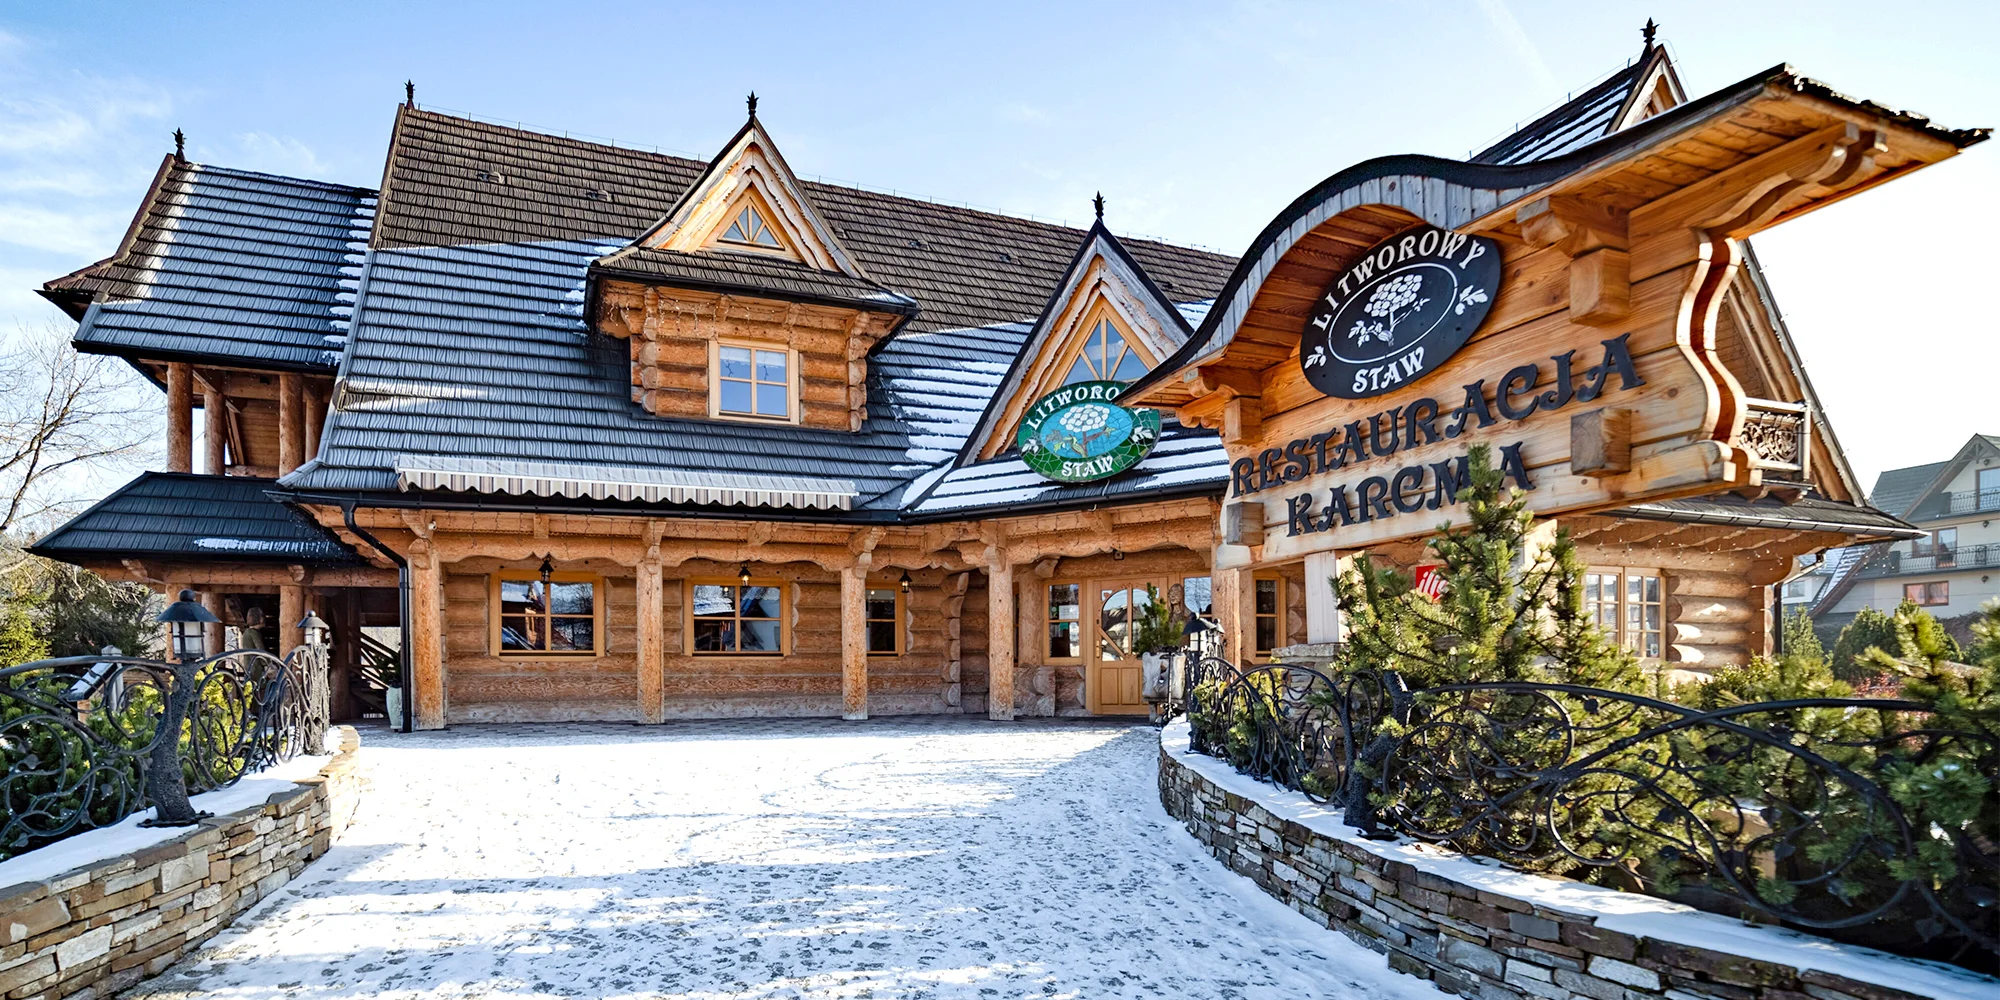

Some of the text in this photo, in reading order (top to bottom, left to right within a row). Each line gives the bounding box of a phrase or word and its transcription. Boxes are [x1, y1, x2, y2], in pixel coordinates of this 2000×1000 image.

[1312, 229, 1486, 331] LITWOROWY
[1352, 346, 1425, 393] STAW
[1026, 385, 1149, 430] LITWORO
[1230, 332, 1646, 498] RESTAURACJA
[1061, 455, 1114, 478] STAW
